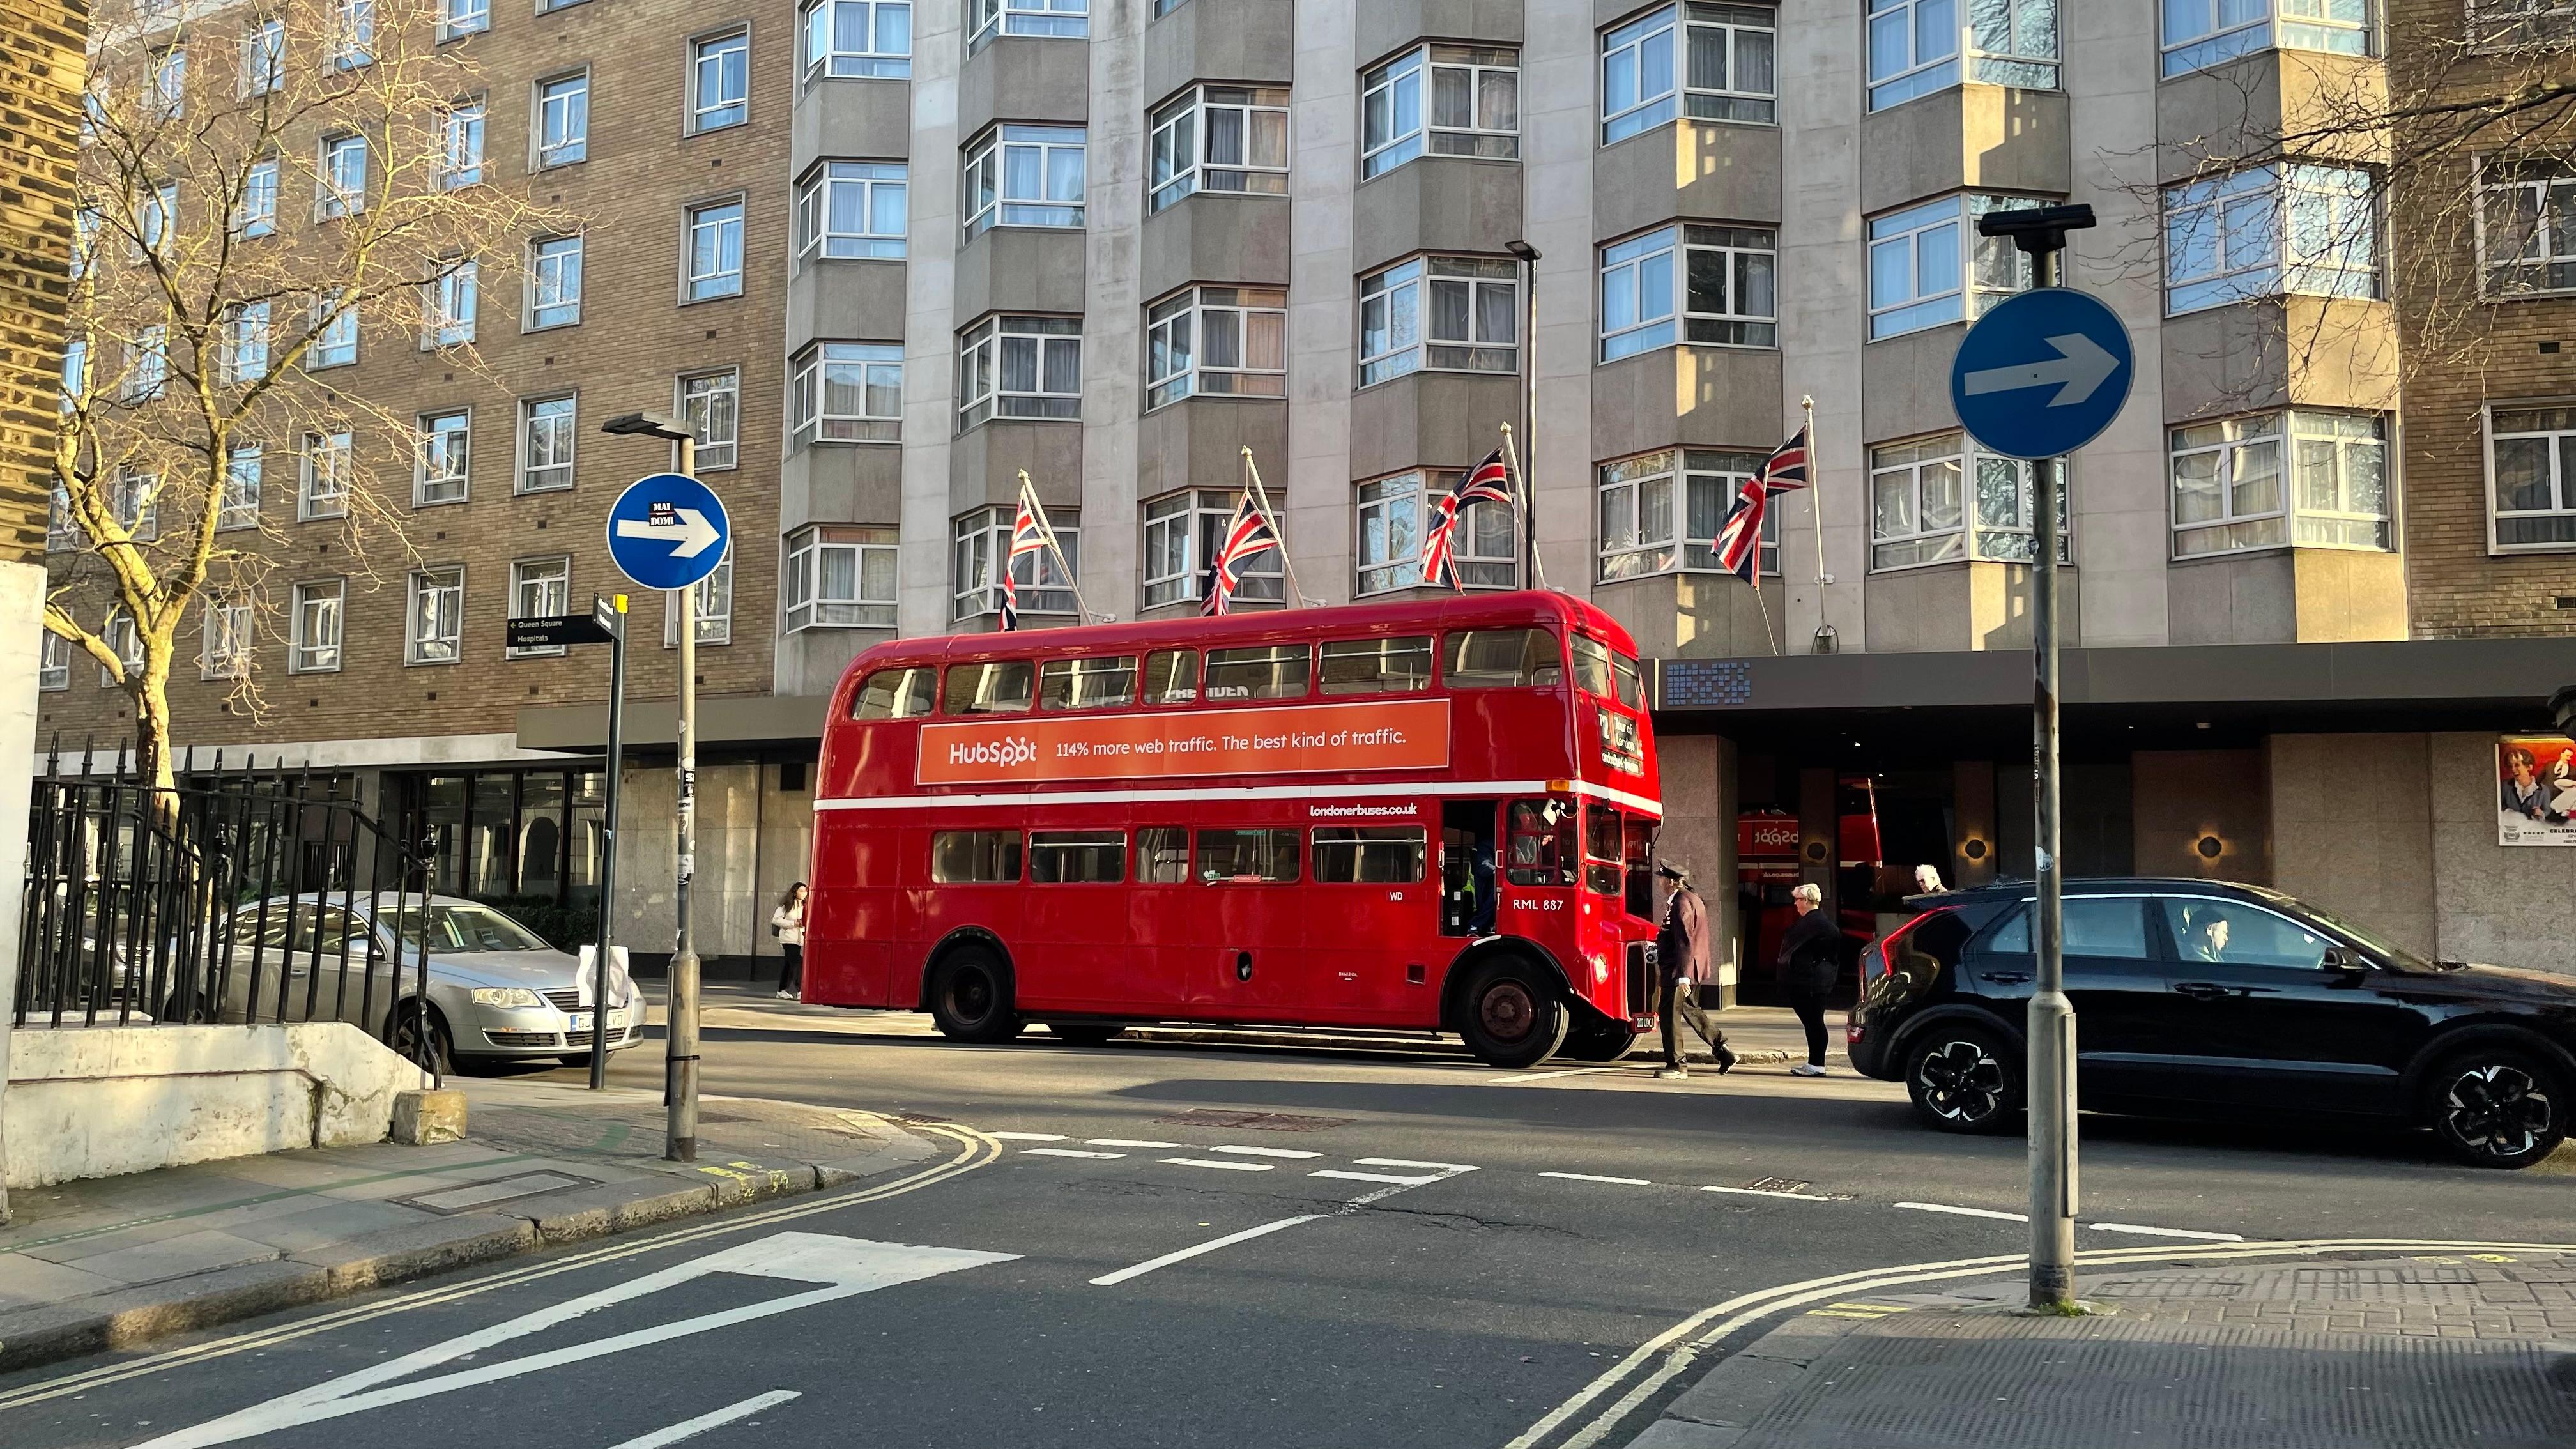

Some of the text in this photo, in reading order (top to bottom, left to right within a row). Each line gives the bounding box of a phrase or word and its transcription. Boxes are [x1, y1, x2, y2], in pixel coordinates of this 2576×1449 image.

[653, 503, 671, 511] MAI
[650, 516, 674, 526] DOMI
[518, 620, 563, 629] Queen Square
[518, 634, 548, 643] Hospitals
[949, 727, 1407, 767] HubSpot 114% more web traffic. The best kind of traffic.
[1310, 802, 1418, 816] londonerbuses.co.uk
[1390, 891, 1403, 901] WD
[1513, 899, 1564, 910] RML 887
